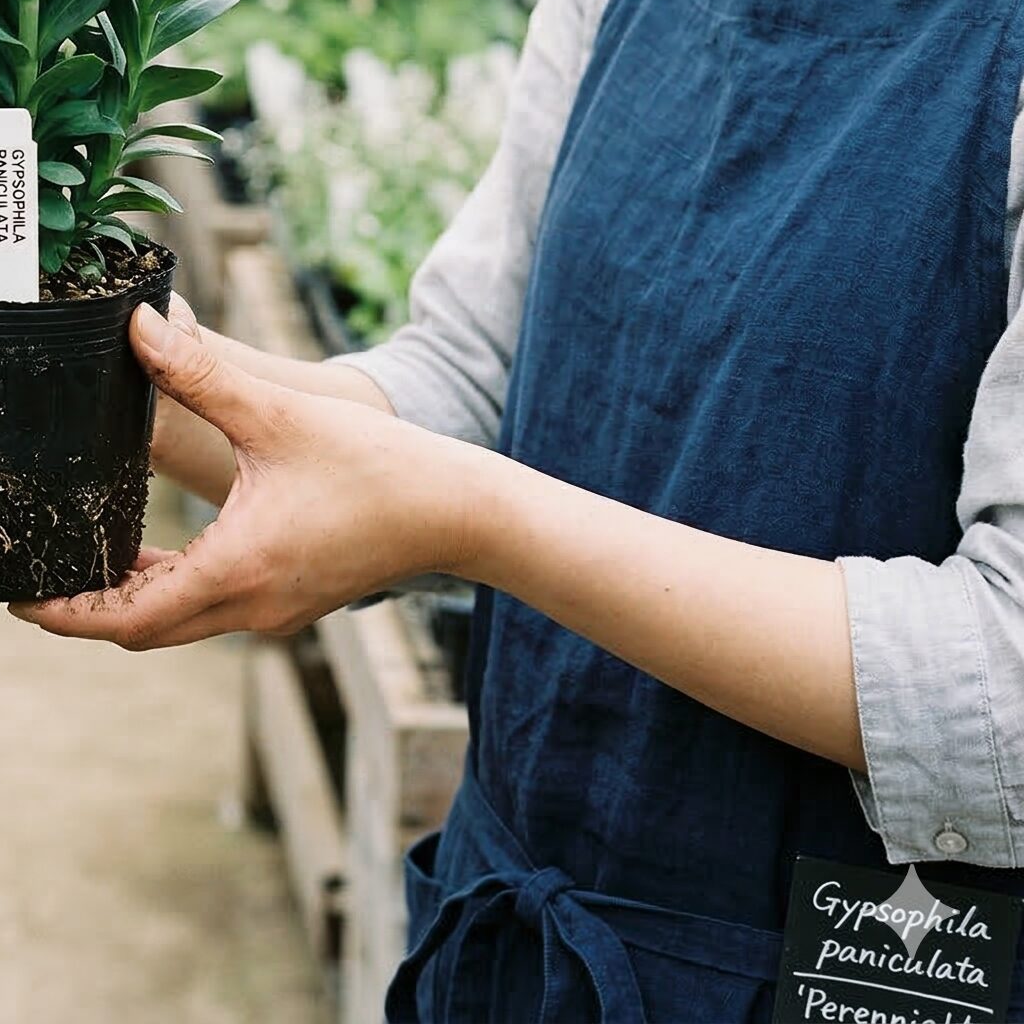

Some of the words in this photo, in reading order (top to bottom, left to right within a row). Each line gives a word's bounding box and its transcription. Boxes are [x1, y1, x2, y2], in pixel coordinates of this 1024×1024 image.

[11, 149, 26, 244] GYPSOPHILA
[812, 880, 992, 940] Gypsophila
[816, 939, 989, 988] paniculata
